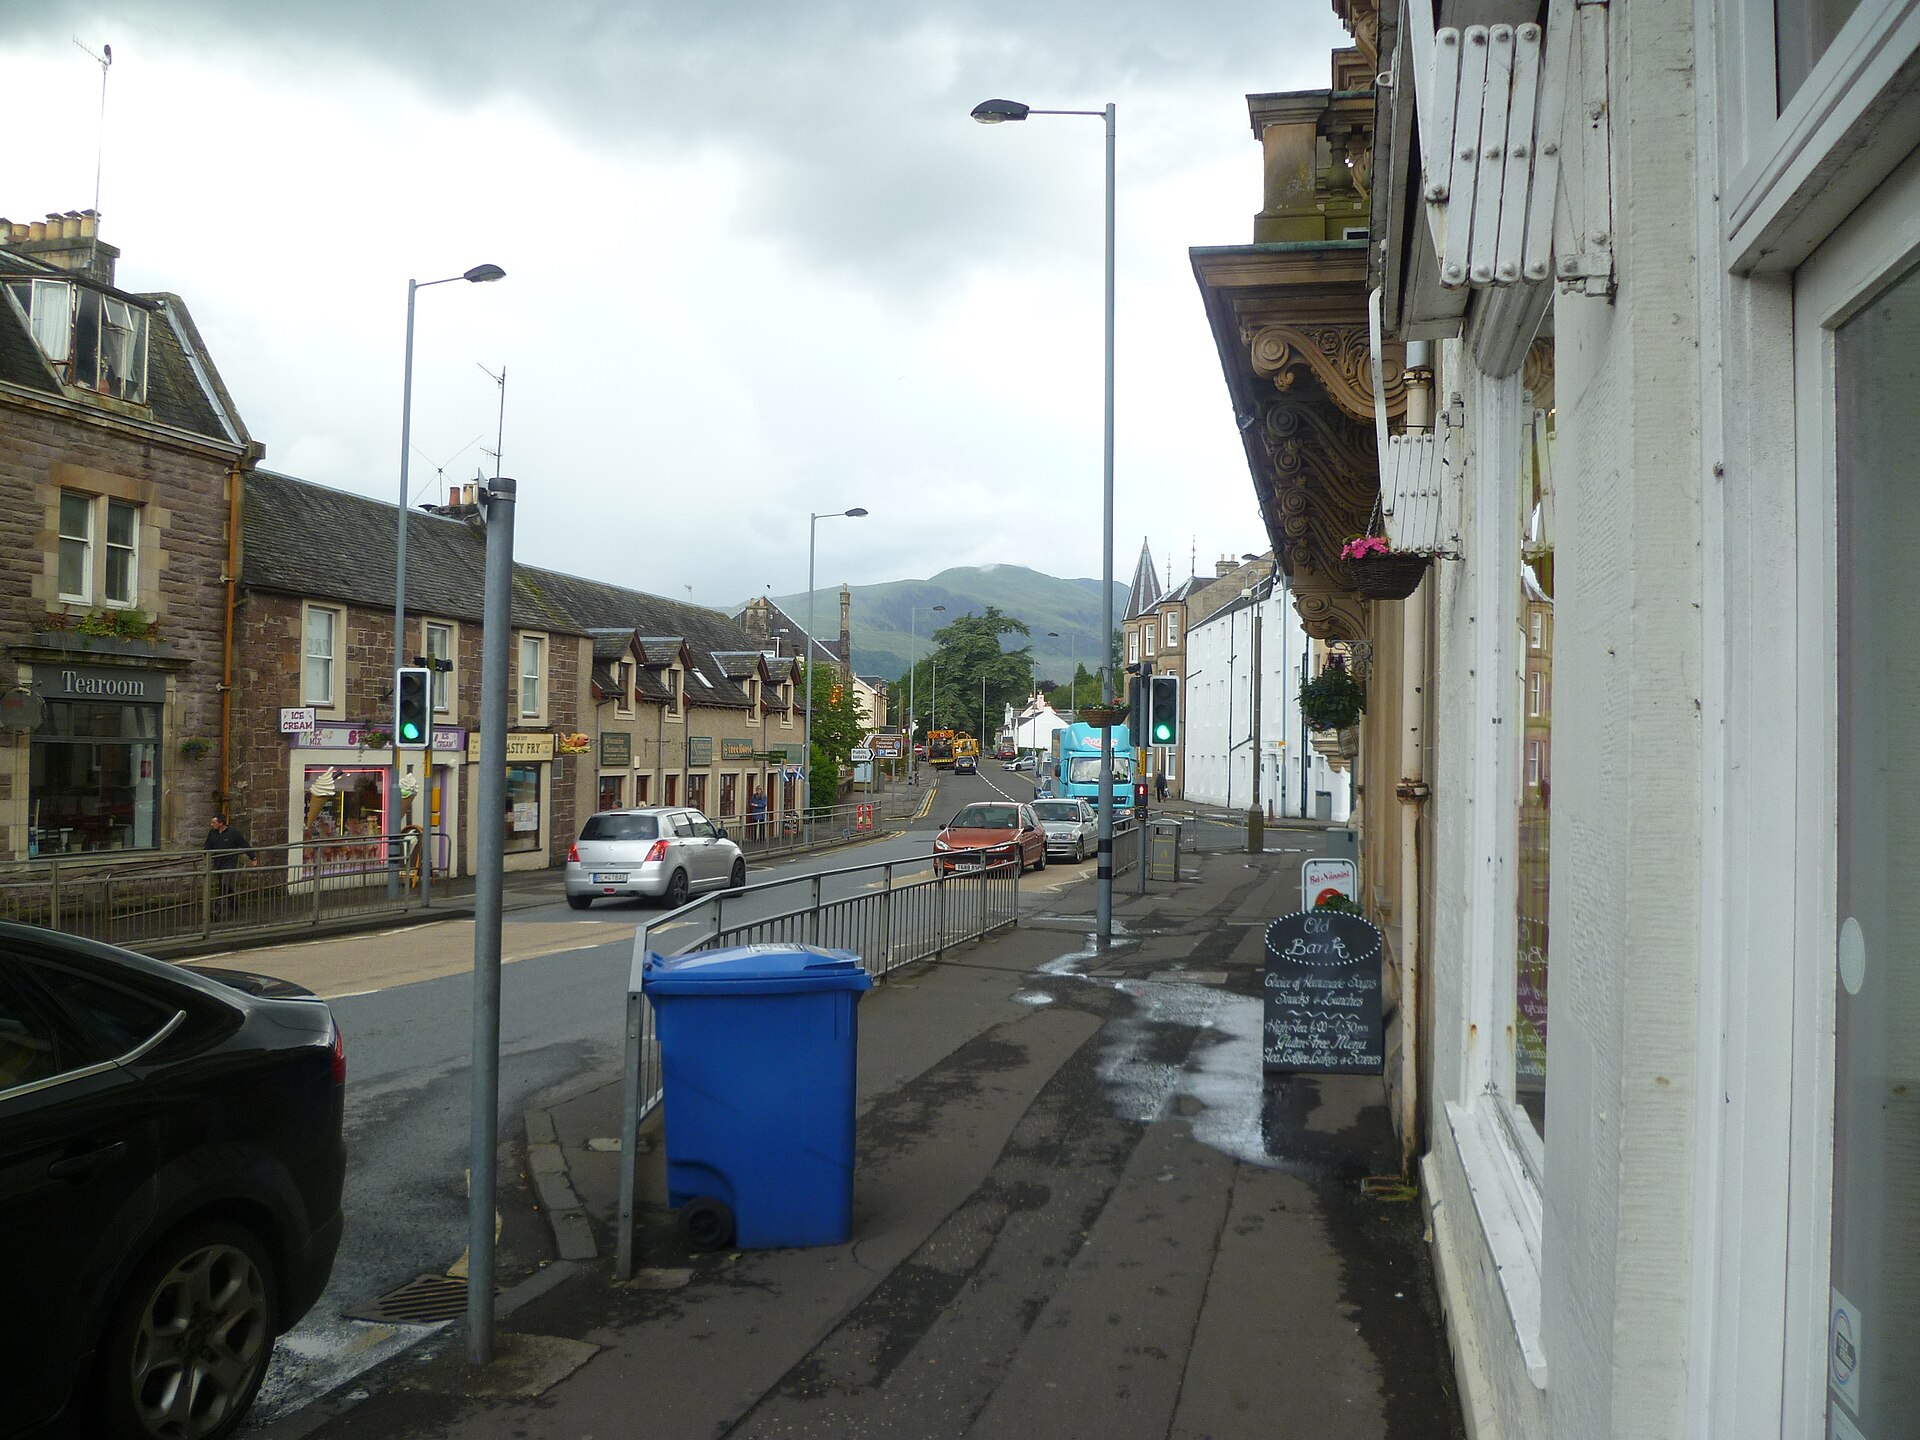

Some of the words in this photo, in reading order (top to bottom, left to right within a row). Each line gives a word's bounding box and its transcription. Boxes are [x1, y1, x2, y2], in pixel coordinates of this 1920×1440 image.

[62, 671, 144, 696] Tearoom
[283, 722, 313, 730] CREAM
[309, 738, 322, 746] MIX
[507, 743, 524, 753] ASTY
[526, 743, 540, 754] FRY
[1303, 917, 1332, 934] Old
[1285, 937, 1350, 959] Bank
[1264, 972, 1291, 989] Choice
[1292, 977, 1301, 991] of
[1303, 974, 1346, 989] Homemade
[1348, 974, 1377, 993] Soups
[1275, 991, 1310, 1007] Snacks
[1321, 991, 1364, 1007] Lunches
[1265, 1019, 1289, 1036] High
[1289, 1019, 1308, 1033] Tea
[1275, 1033, 1306, 1051] Gluten
[1306, 1034, 1331, 1049] Free
[1331, 1034, 1367, 1050] Menu
[1348, 1049, 1382, 1065] Scones
